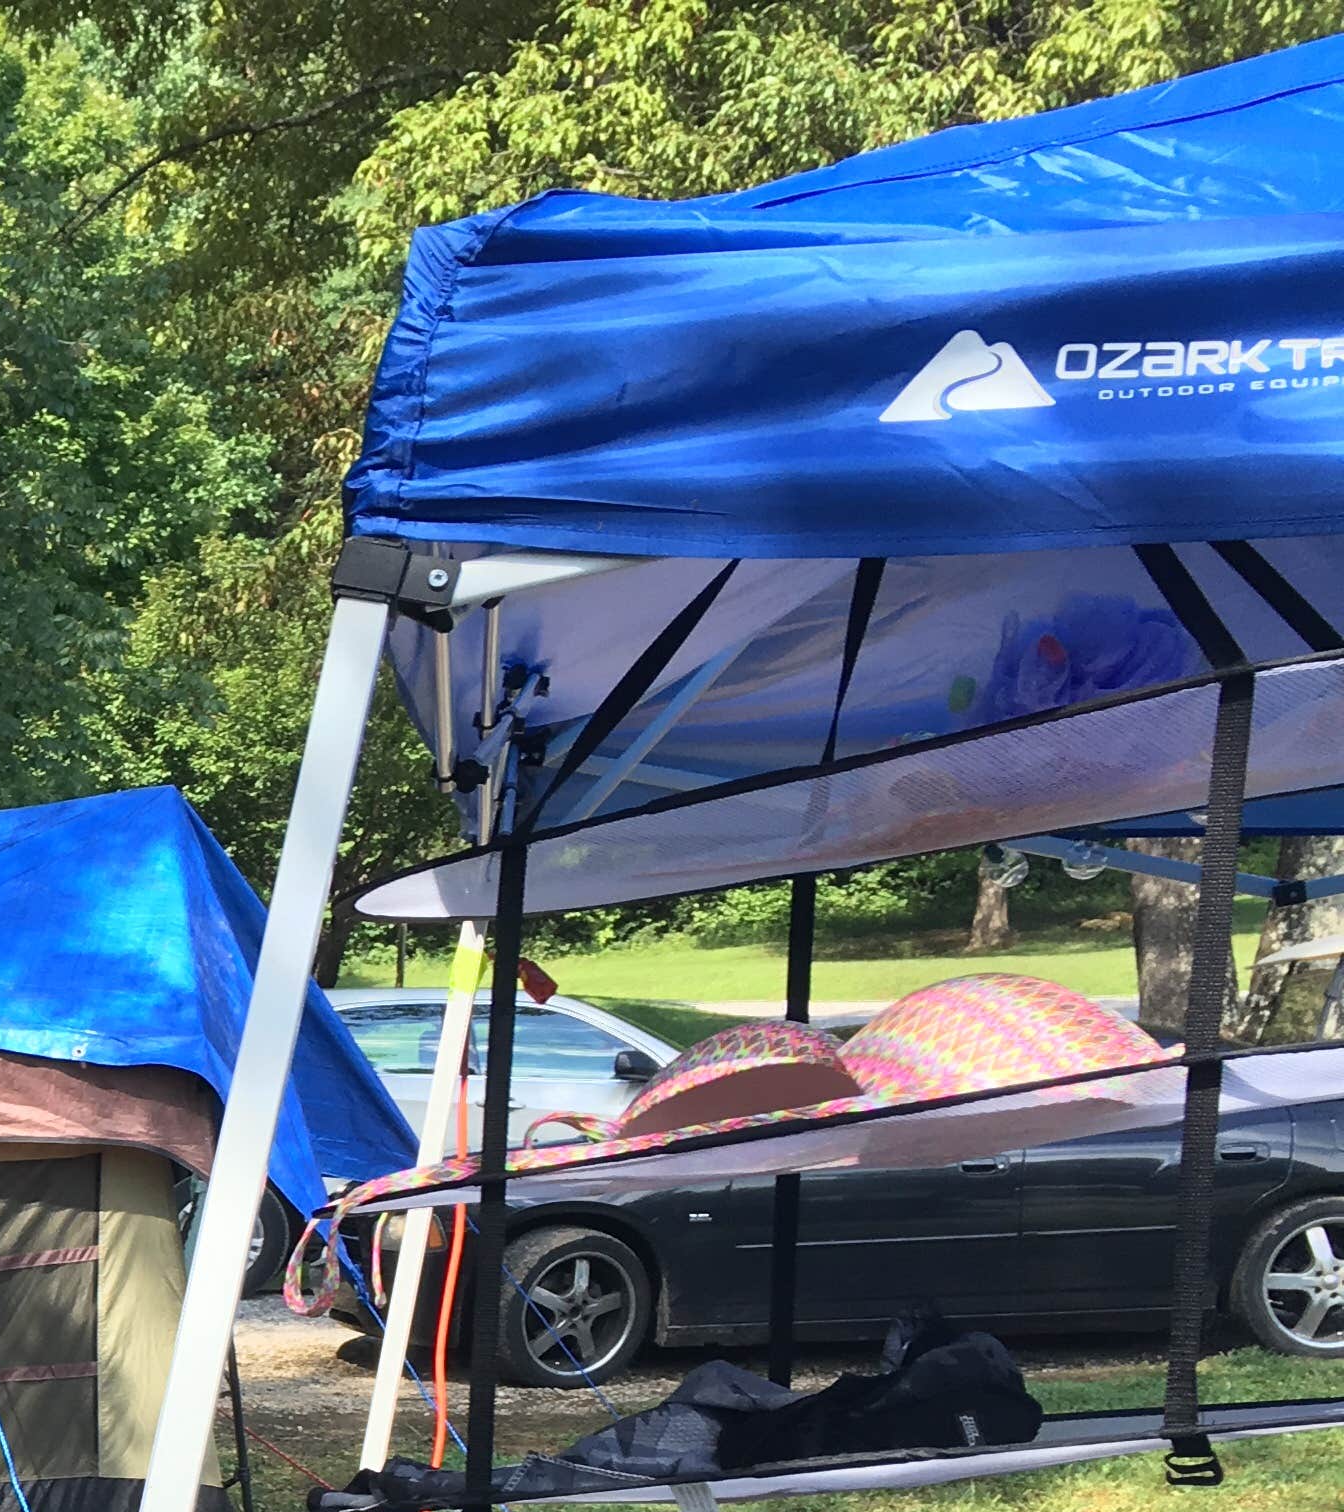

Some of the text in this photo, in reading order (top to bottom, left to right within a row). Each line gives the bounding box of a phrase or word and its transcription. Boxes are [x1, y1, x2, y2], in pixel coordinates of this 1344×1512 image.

[1055, 339, 1272, 380] OZARK
[1098, 375, 1344, 400] OUTDOOR EQUIP
